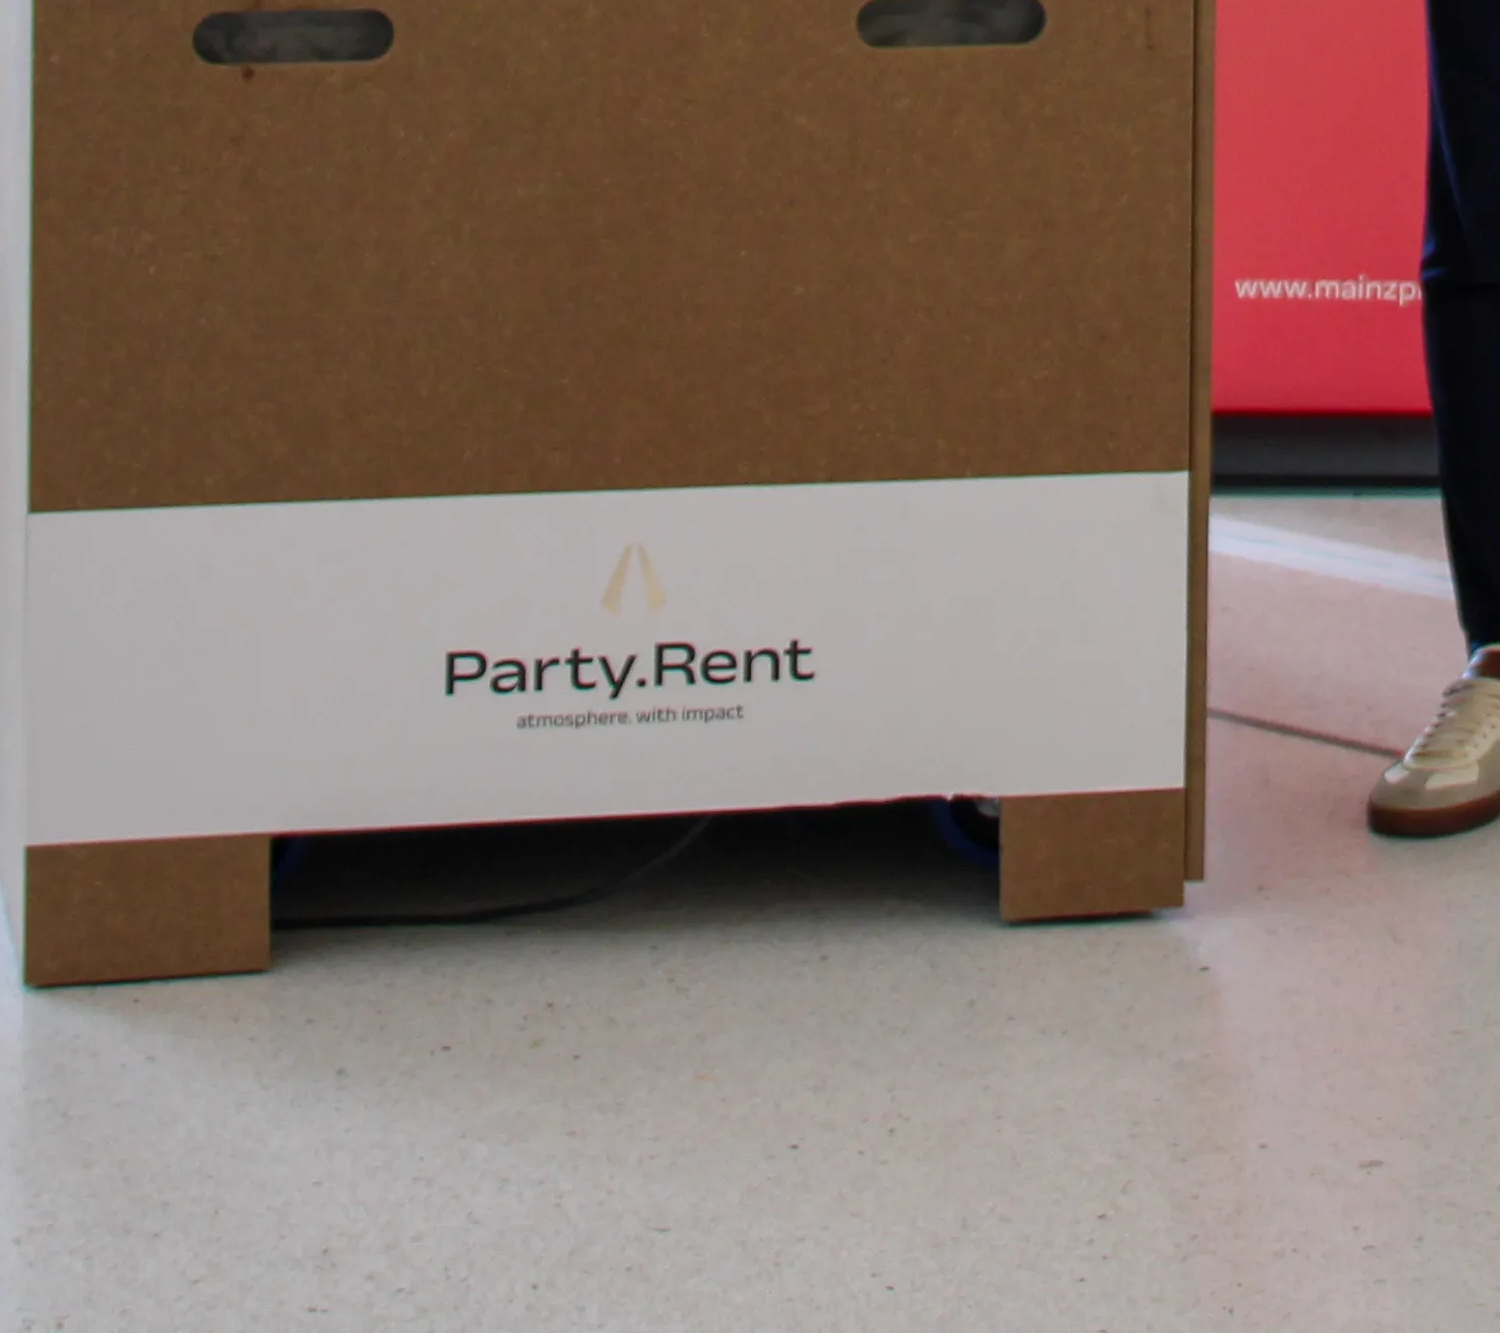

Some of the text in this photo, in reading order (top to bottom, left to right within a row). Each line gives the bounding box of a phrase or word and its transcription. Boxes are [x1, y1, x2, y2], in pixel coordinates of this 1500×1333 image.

[445, 639, 816, 700] Party.Rent
[636, 705, 678, 724] with
[682, 703, 745, 723] impact
